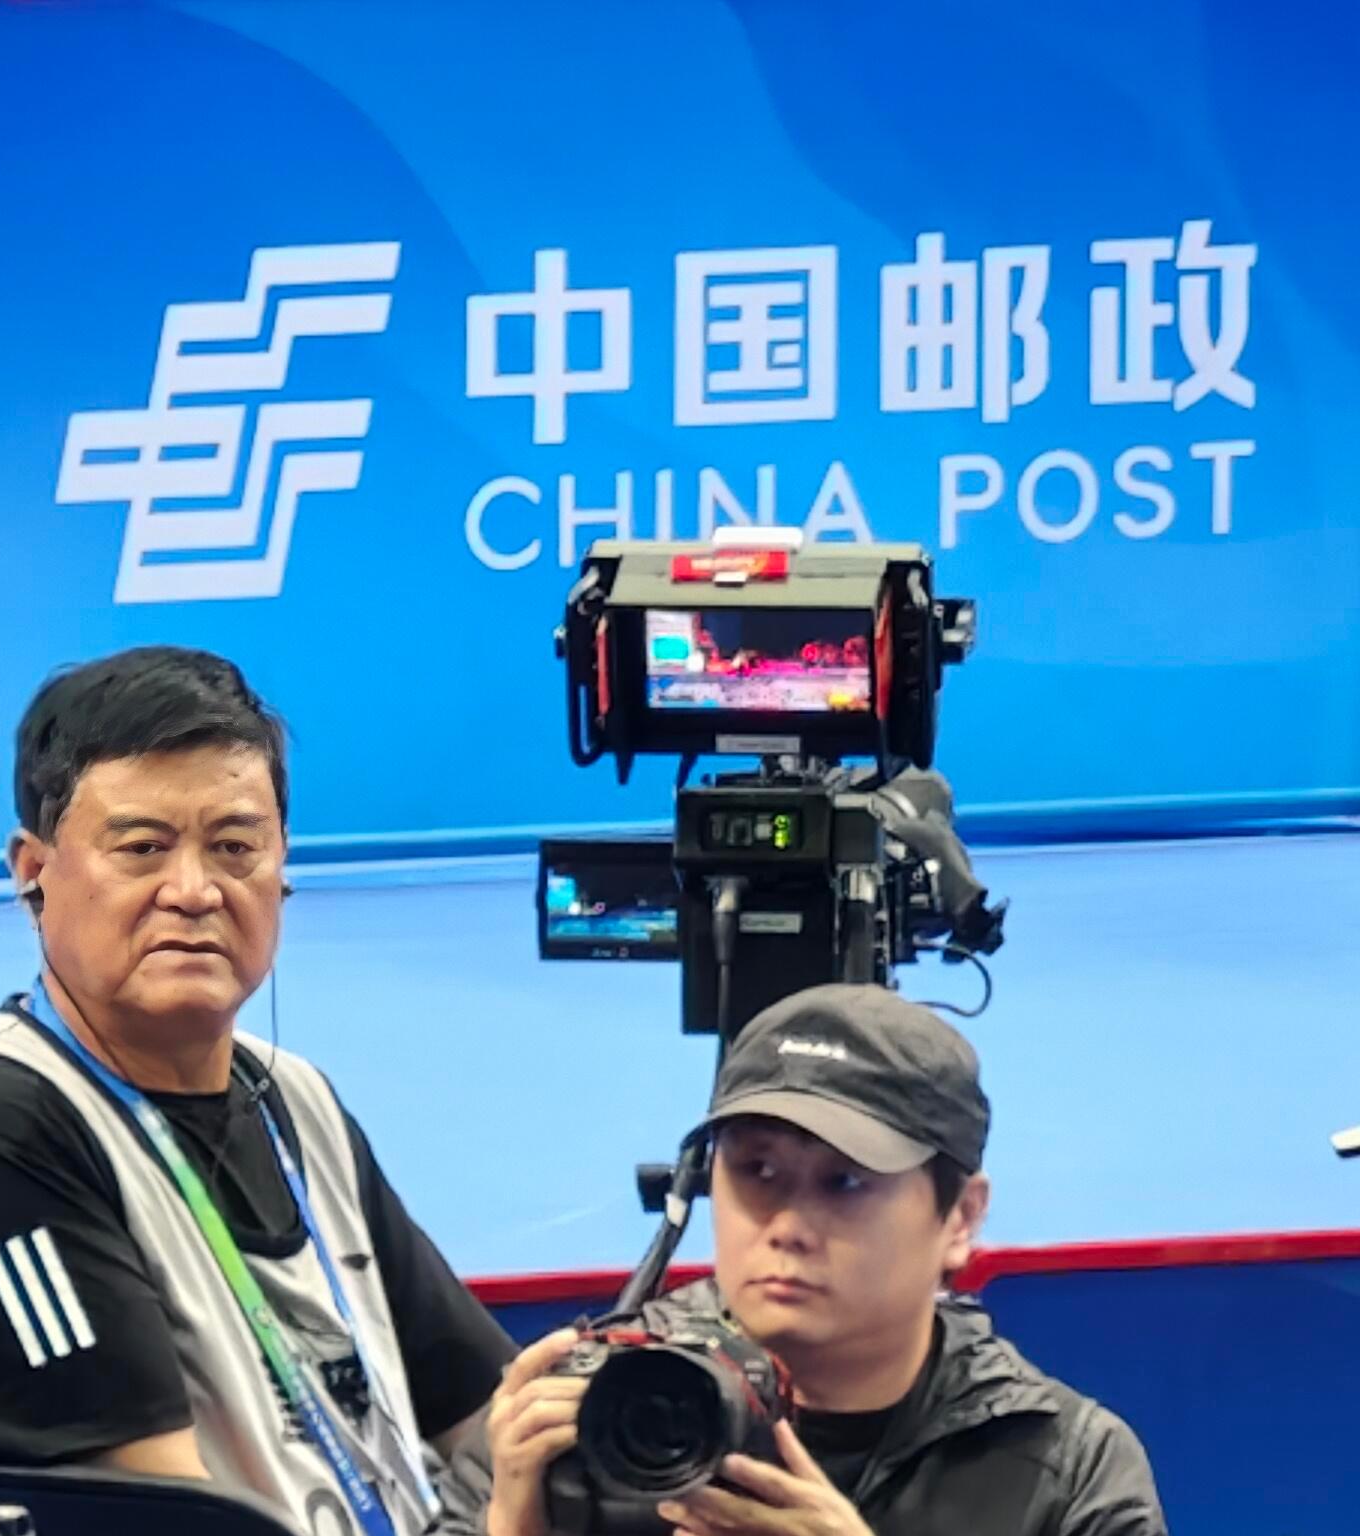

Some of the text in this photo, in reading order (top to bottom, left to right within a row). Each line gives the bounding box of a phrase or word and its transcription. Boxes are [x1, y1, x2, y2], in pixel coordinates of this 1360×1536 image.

[465, 220, 1260, 446] 中国邮政
[464, 439, 1257, 573] CHINA POST
